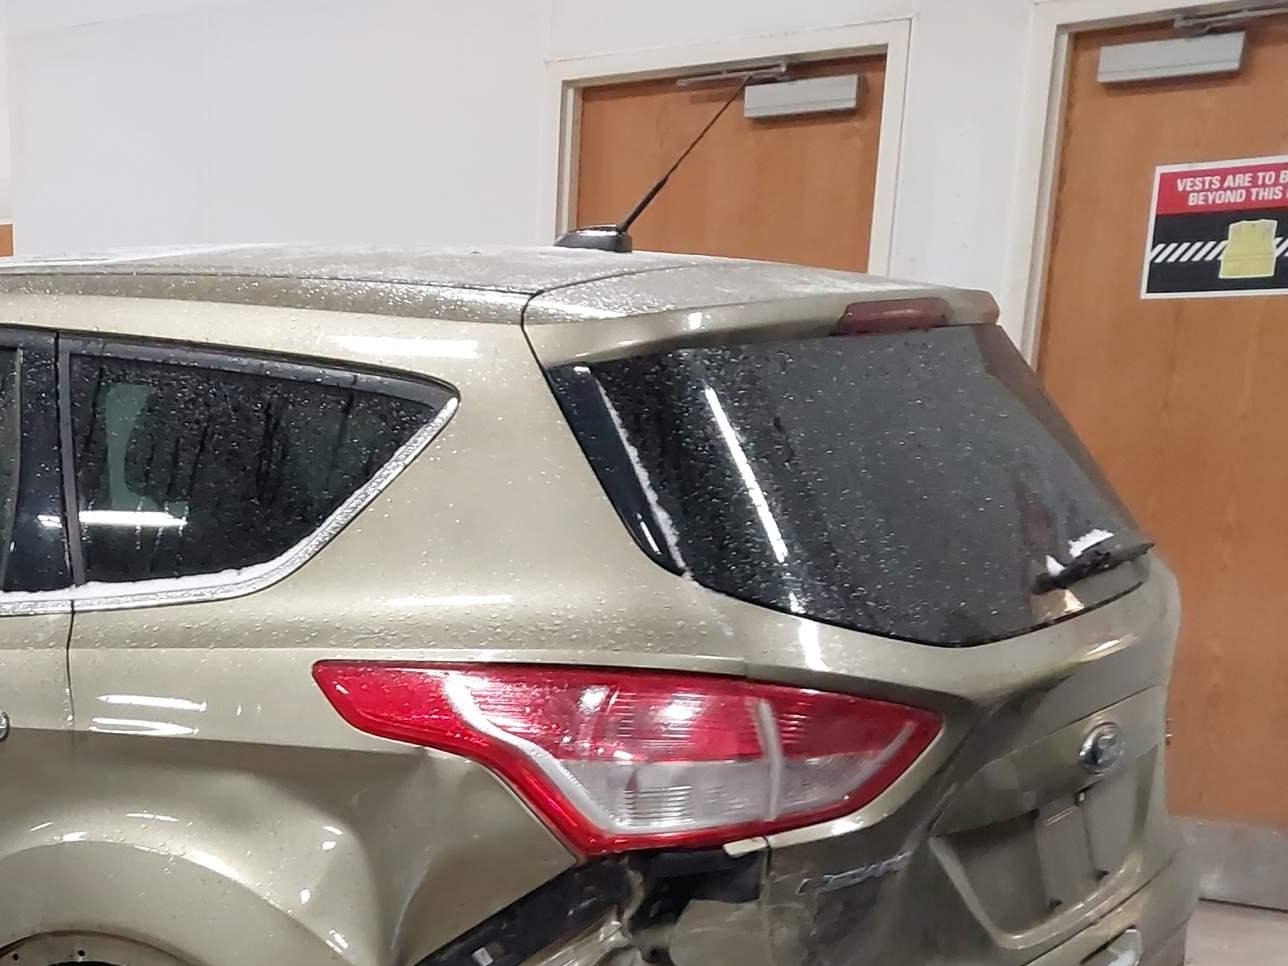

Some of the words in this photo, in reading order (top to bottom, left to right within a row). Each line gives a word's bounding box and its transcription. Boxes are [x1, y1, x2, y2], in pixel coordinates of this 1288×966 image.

[1176, 175, 1221, 192] VESTS
[1223, 172, 1253, 188] ARE
[1257, 171, 1276, 185] TO
[1188, 188, 1246, 206] BEYOND
[1250, 186, 1284, 201] THIS
